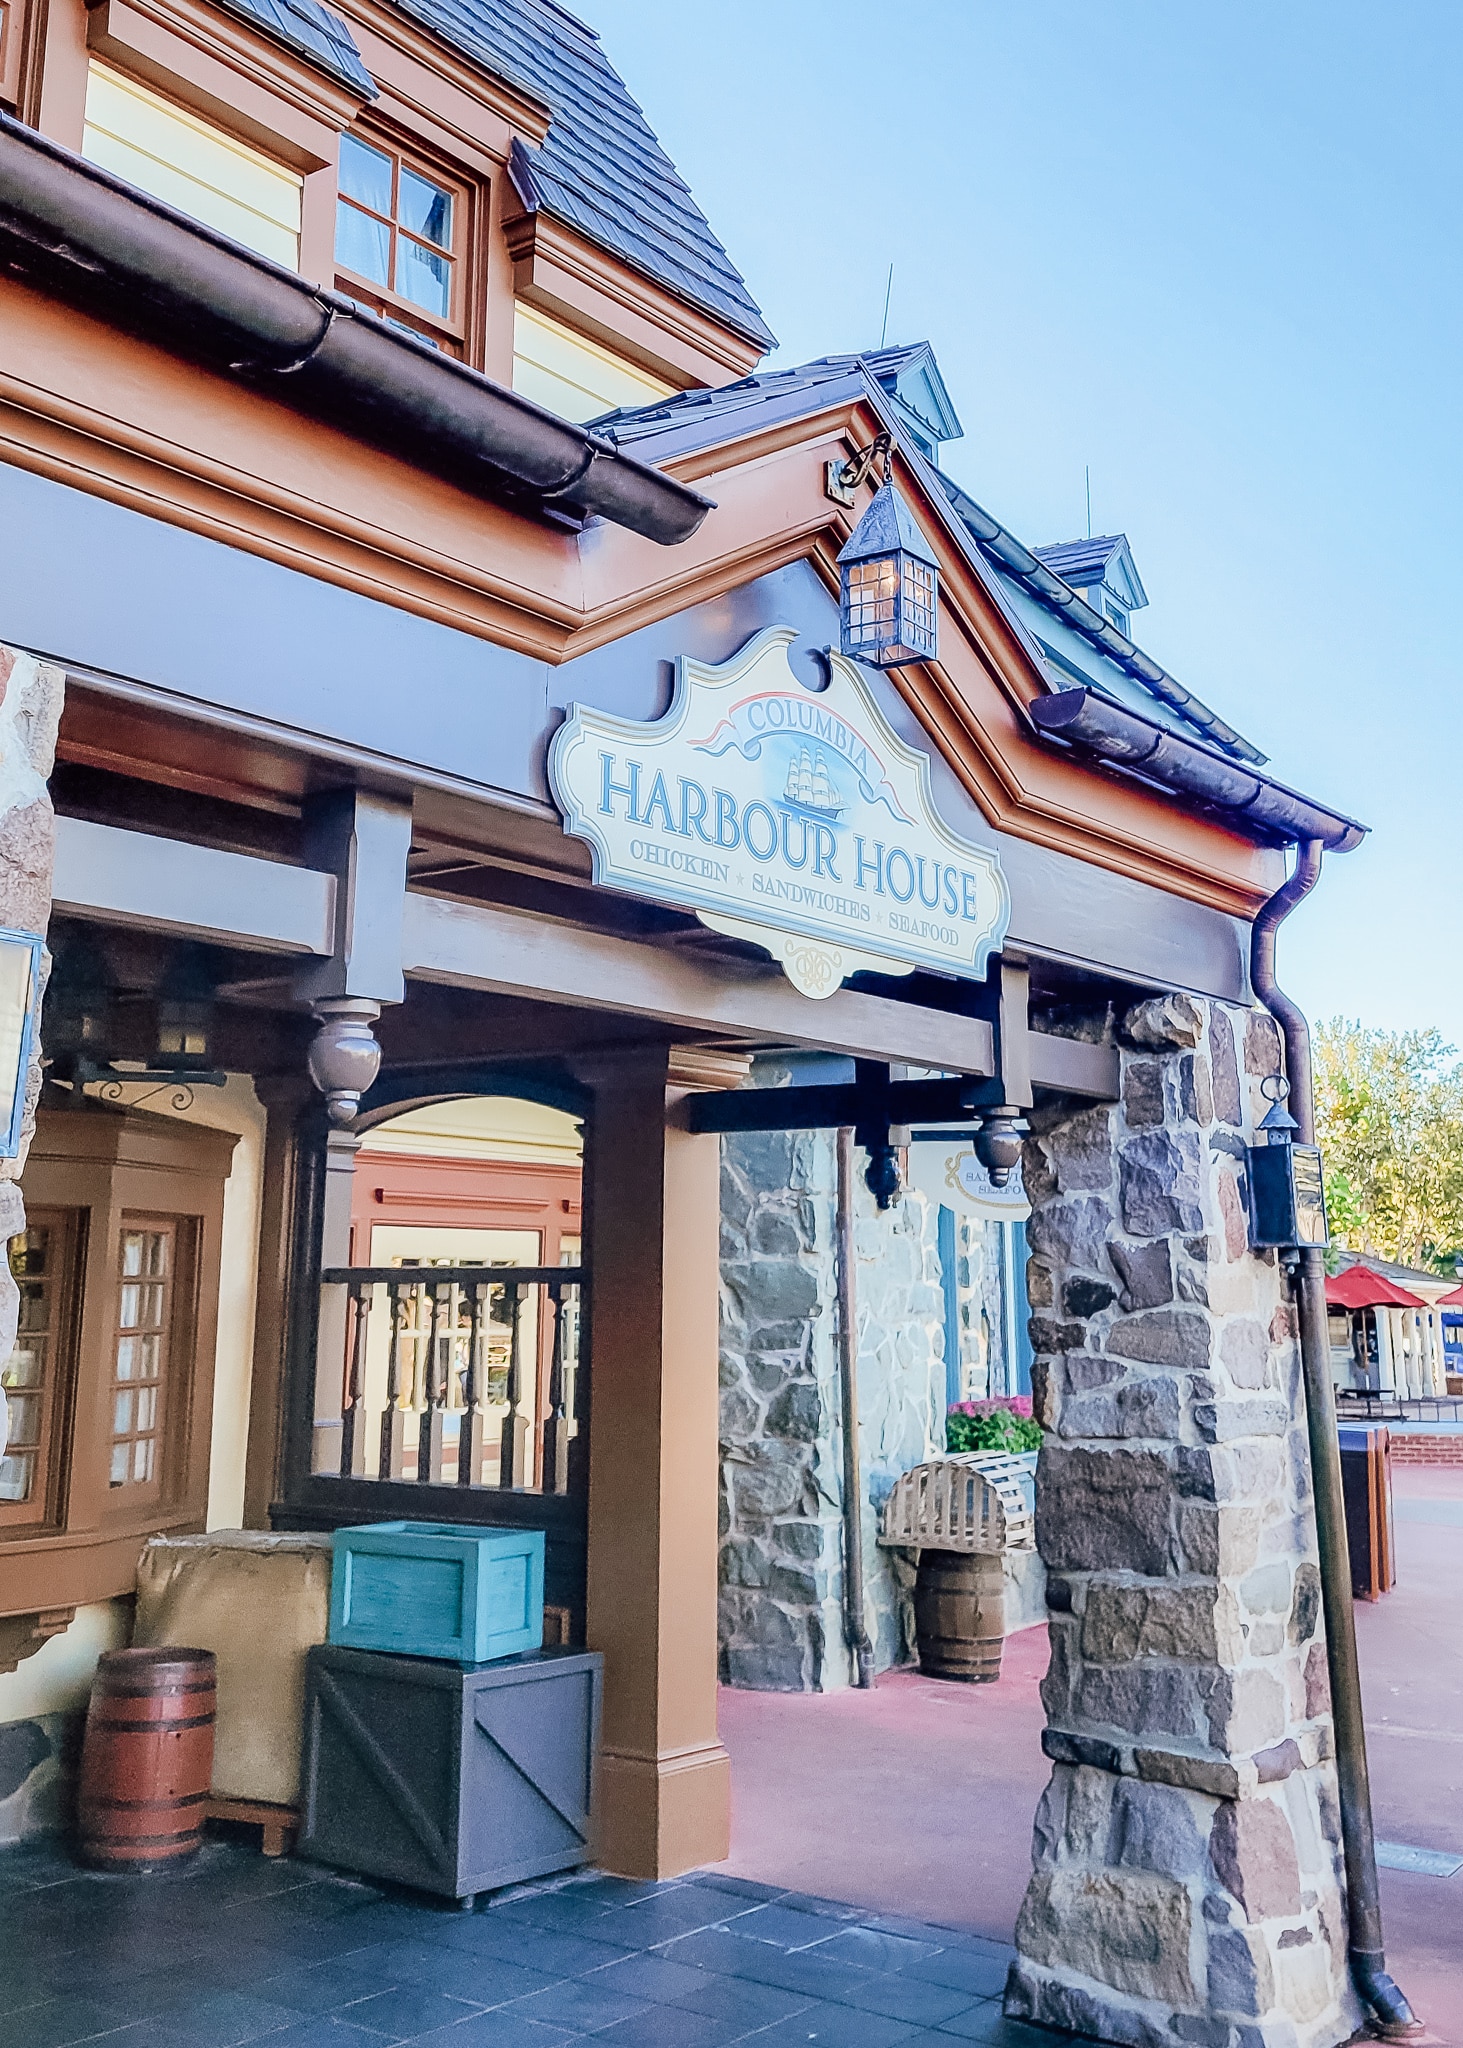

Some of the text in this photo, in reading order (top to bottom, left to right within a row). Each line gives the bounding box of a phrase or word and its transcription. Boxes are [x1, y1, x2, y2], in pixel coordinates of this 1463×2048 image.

[747, 698, 868, 775] COLUMBIA
[598, 752, 978, 922] HARBOUR HOUSE
[629, 839, 960, 947] CHICKEN SANDWICHES SEAFOOD
